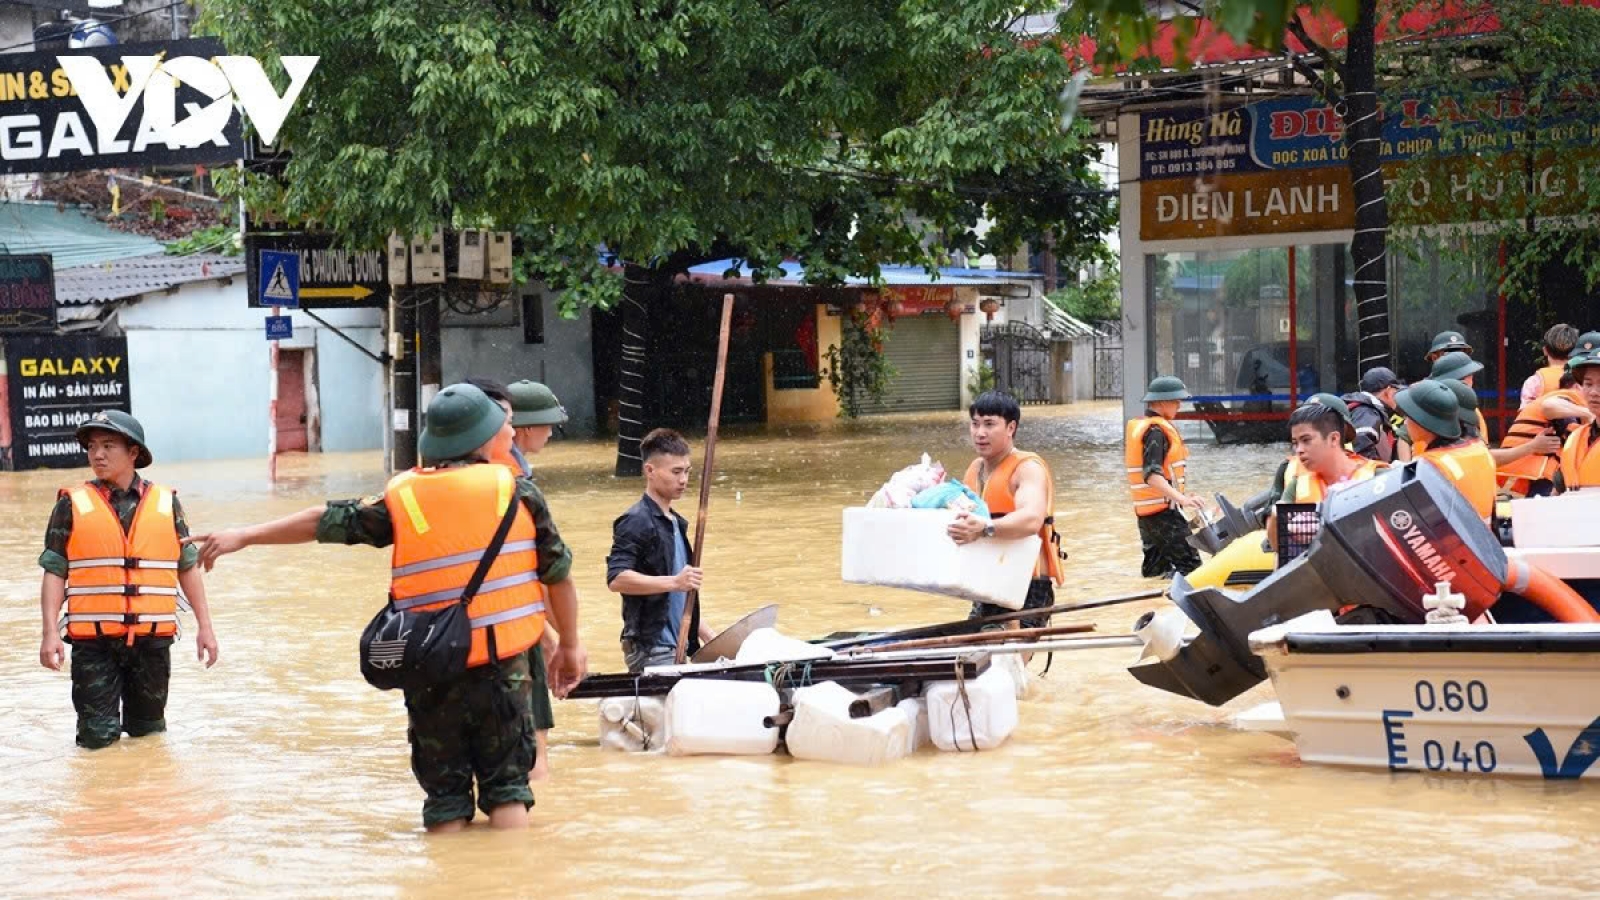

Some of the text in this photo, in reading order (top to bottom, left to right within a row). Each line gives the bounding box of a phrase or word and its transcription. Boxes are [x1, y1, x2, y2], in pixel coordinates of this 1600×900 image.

[28, 71, 48, 99] &
[1145, 110, 1242, 145] Hùng Hà
[1155, 183, 1339, 229] ĐIỆN LẠNH
[20, 356, 121, 377] GALAXY
[23, 386, 37, 399] IN
[66, 381, 90, 397] SẢN
[92, 380, 123, 396] XUẤT
[51, 411, 64, 426] BÌ
[28, 443, 41, 457] IN
[42, 441, 81, 456] NHANH
[1403, 524, 1457, 582] YAMAHA
[1415, 679, 1489, 712] 0.60
[1423, 739, 1497, 773] 0.40
